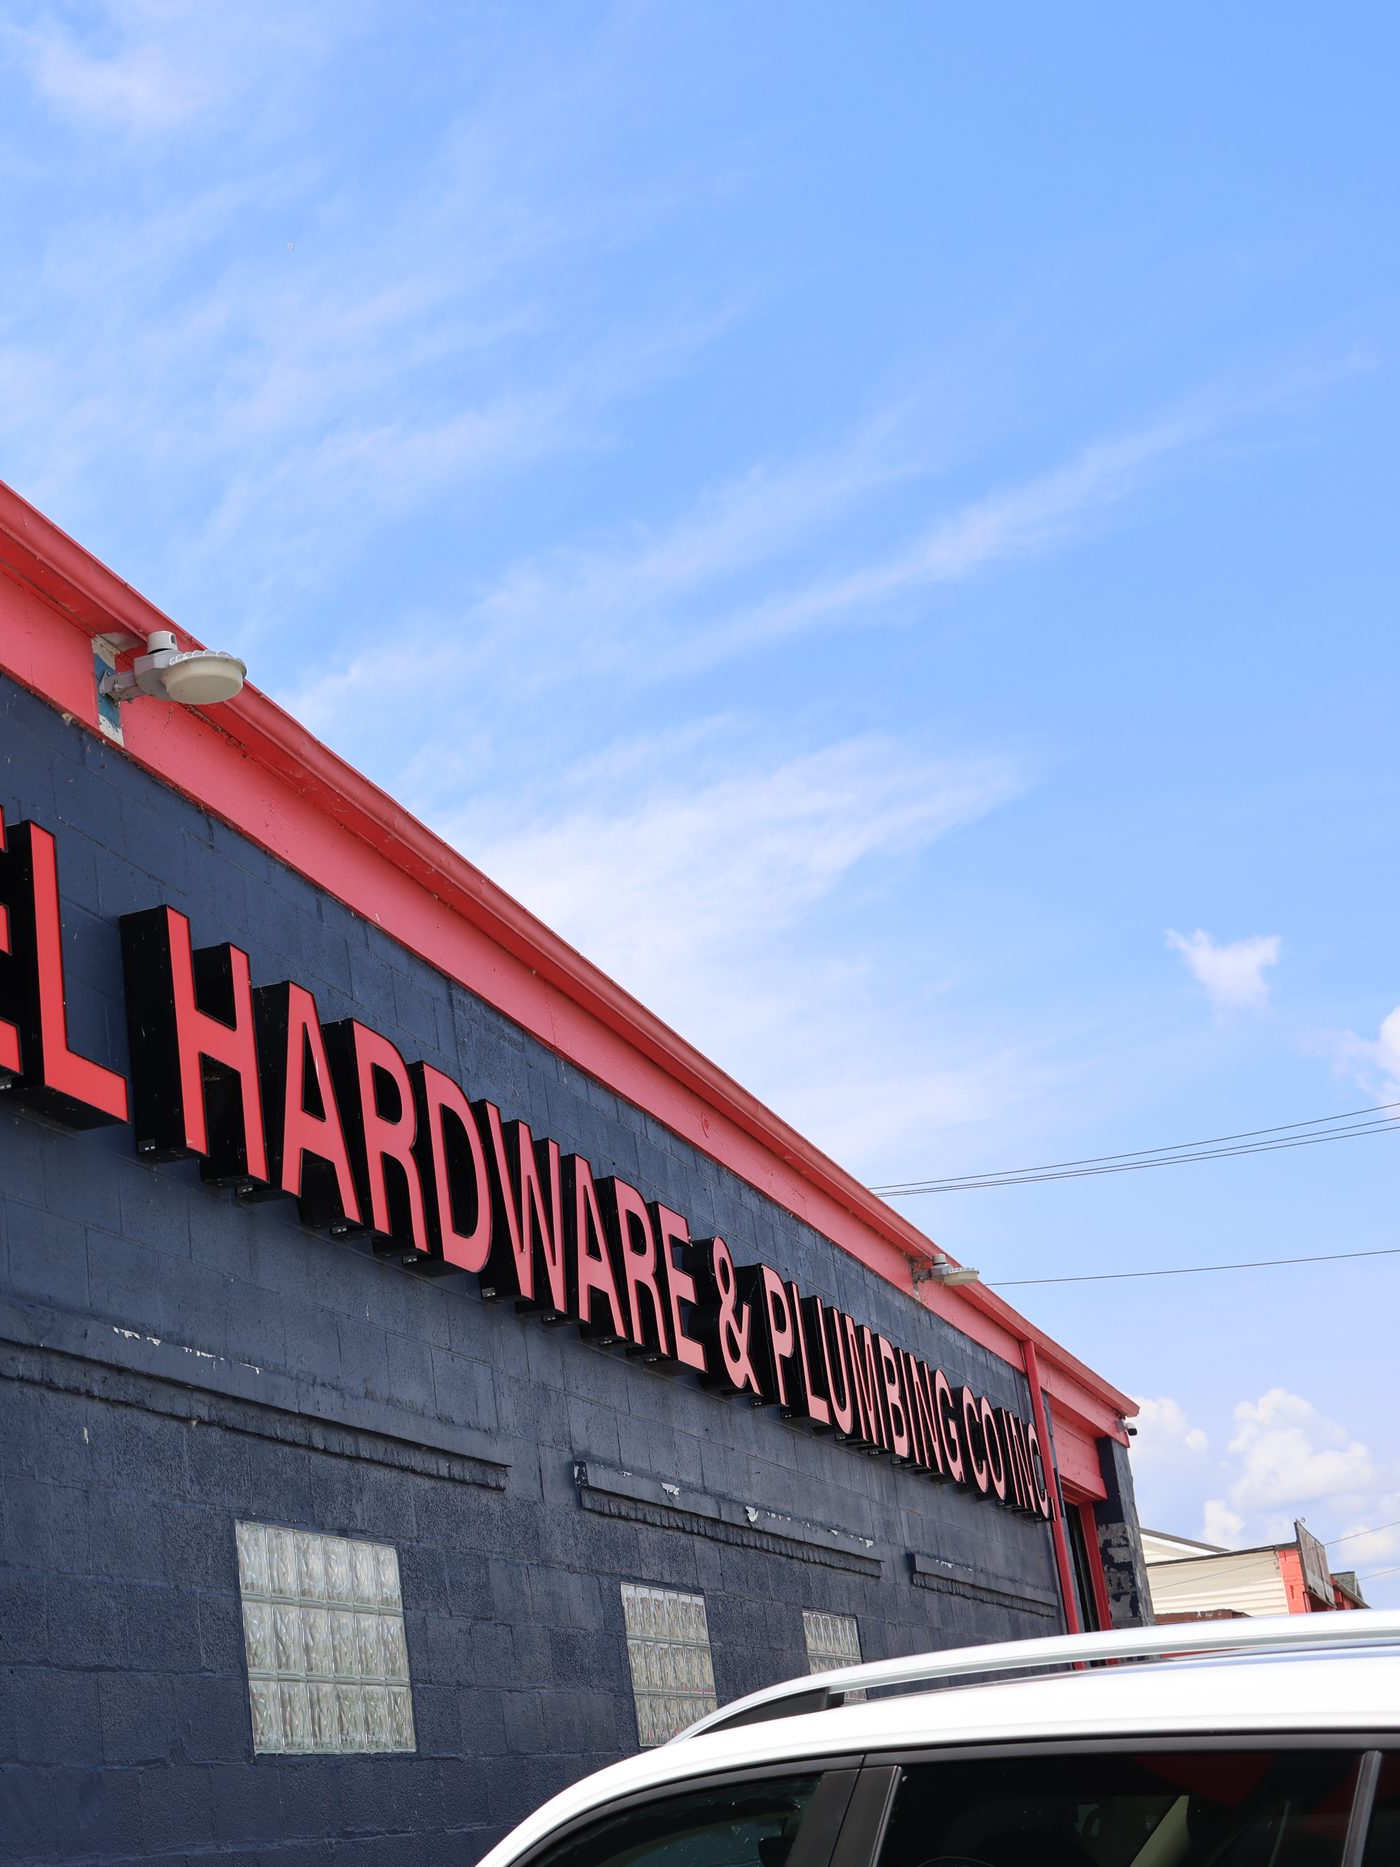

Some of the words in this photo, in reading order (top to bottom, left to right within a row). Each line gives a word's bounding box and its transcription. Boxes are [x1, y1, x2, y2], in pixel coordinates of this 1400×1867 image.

[166, 904, 707, 1372] HARDWARE
[711, 1235, 764, 1396] &
[761, 1263, 966, 1483] PLUMBING
